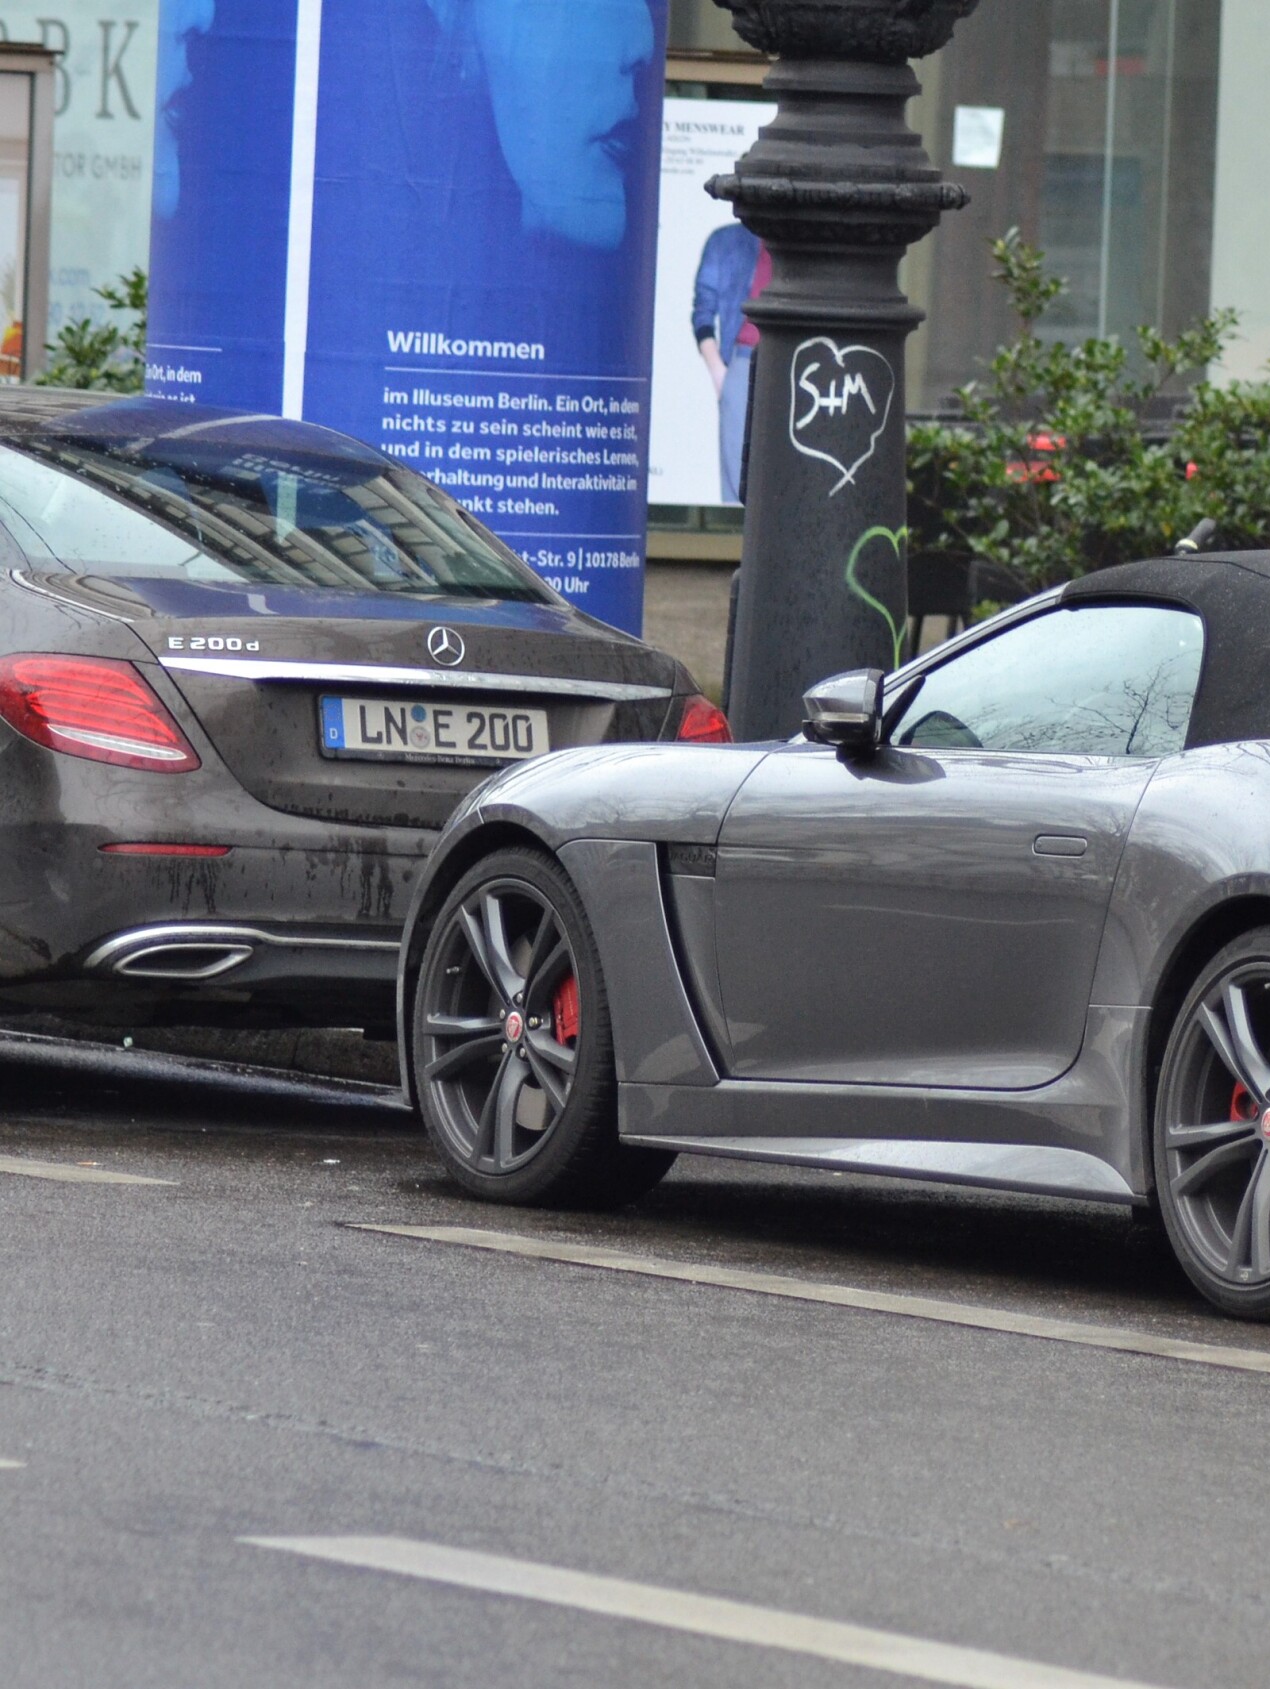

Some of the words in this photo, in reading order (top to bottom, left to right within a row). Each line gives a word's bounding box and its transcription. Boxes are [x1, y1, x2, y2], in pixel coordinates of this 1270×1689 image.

[675, 122, 745, 136] MENSWEAR
[387, 330, 545, 360] Willkommen
[167, 364, 175, 381] in
[177, 365, 202, 383] dem
[383, 387, 408, 404] im
[412, 388, 494, 409] Illuseum
[498, 392, 552, 412] Berlin.
[556, 396, 579, 413] Ein
[582, 396, 608, 416] Ort,
[609, 397, 620, 414] in
[620, 398, 639, 414] dem
[796, 362, 876, 430] S+M
[382, 414, 446, 432] nichts
[451, 419, 474, 433] zu
[480, 418, 518, 436] sein
[522, 420, 582, 438] scheint
[585, 423, 608, 439] wie
[609, 427, 622, 440] es
[623, 425, 638, 442] ist,
[381, 441, 419, 458] und
[424, 441, 443, 458] in
[448, 442, 491, 460] dem
[496, 445, 601, 466] spielerisches
[603, 448, 639, 467] Lernen,
[507, 473, 539, 489] und
[542, 475, 626, 490] Interaktivität
[497, 498, 559, 515] stehen.
[567, 551, 576, 568] 9
[585, 551, 619, 568] 10178
[619, 551, 640, 568] Berlin
[564, 576, 590, 593] Uhr
[168, 637, 184, 651] E
[190, 637, 242, 651] 200
[245, 640, 260, 652] d
[329, 727, 338, 740] D
[359, 704, 407, 747] LN
[433, 708, 457, 749] E
[466, 711, 534, 753] 200
